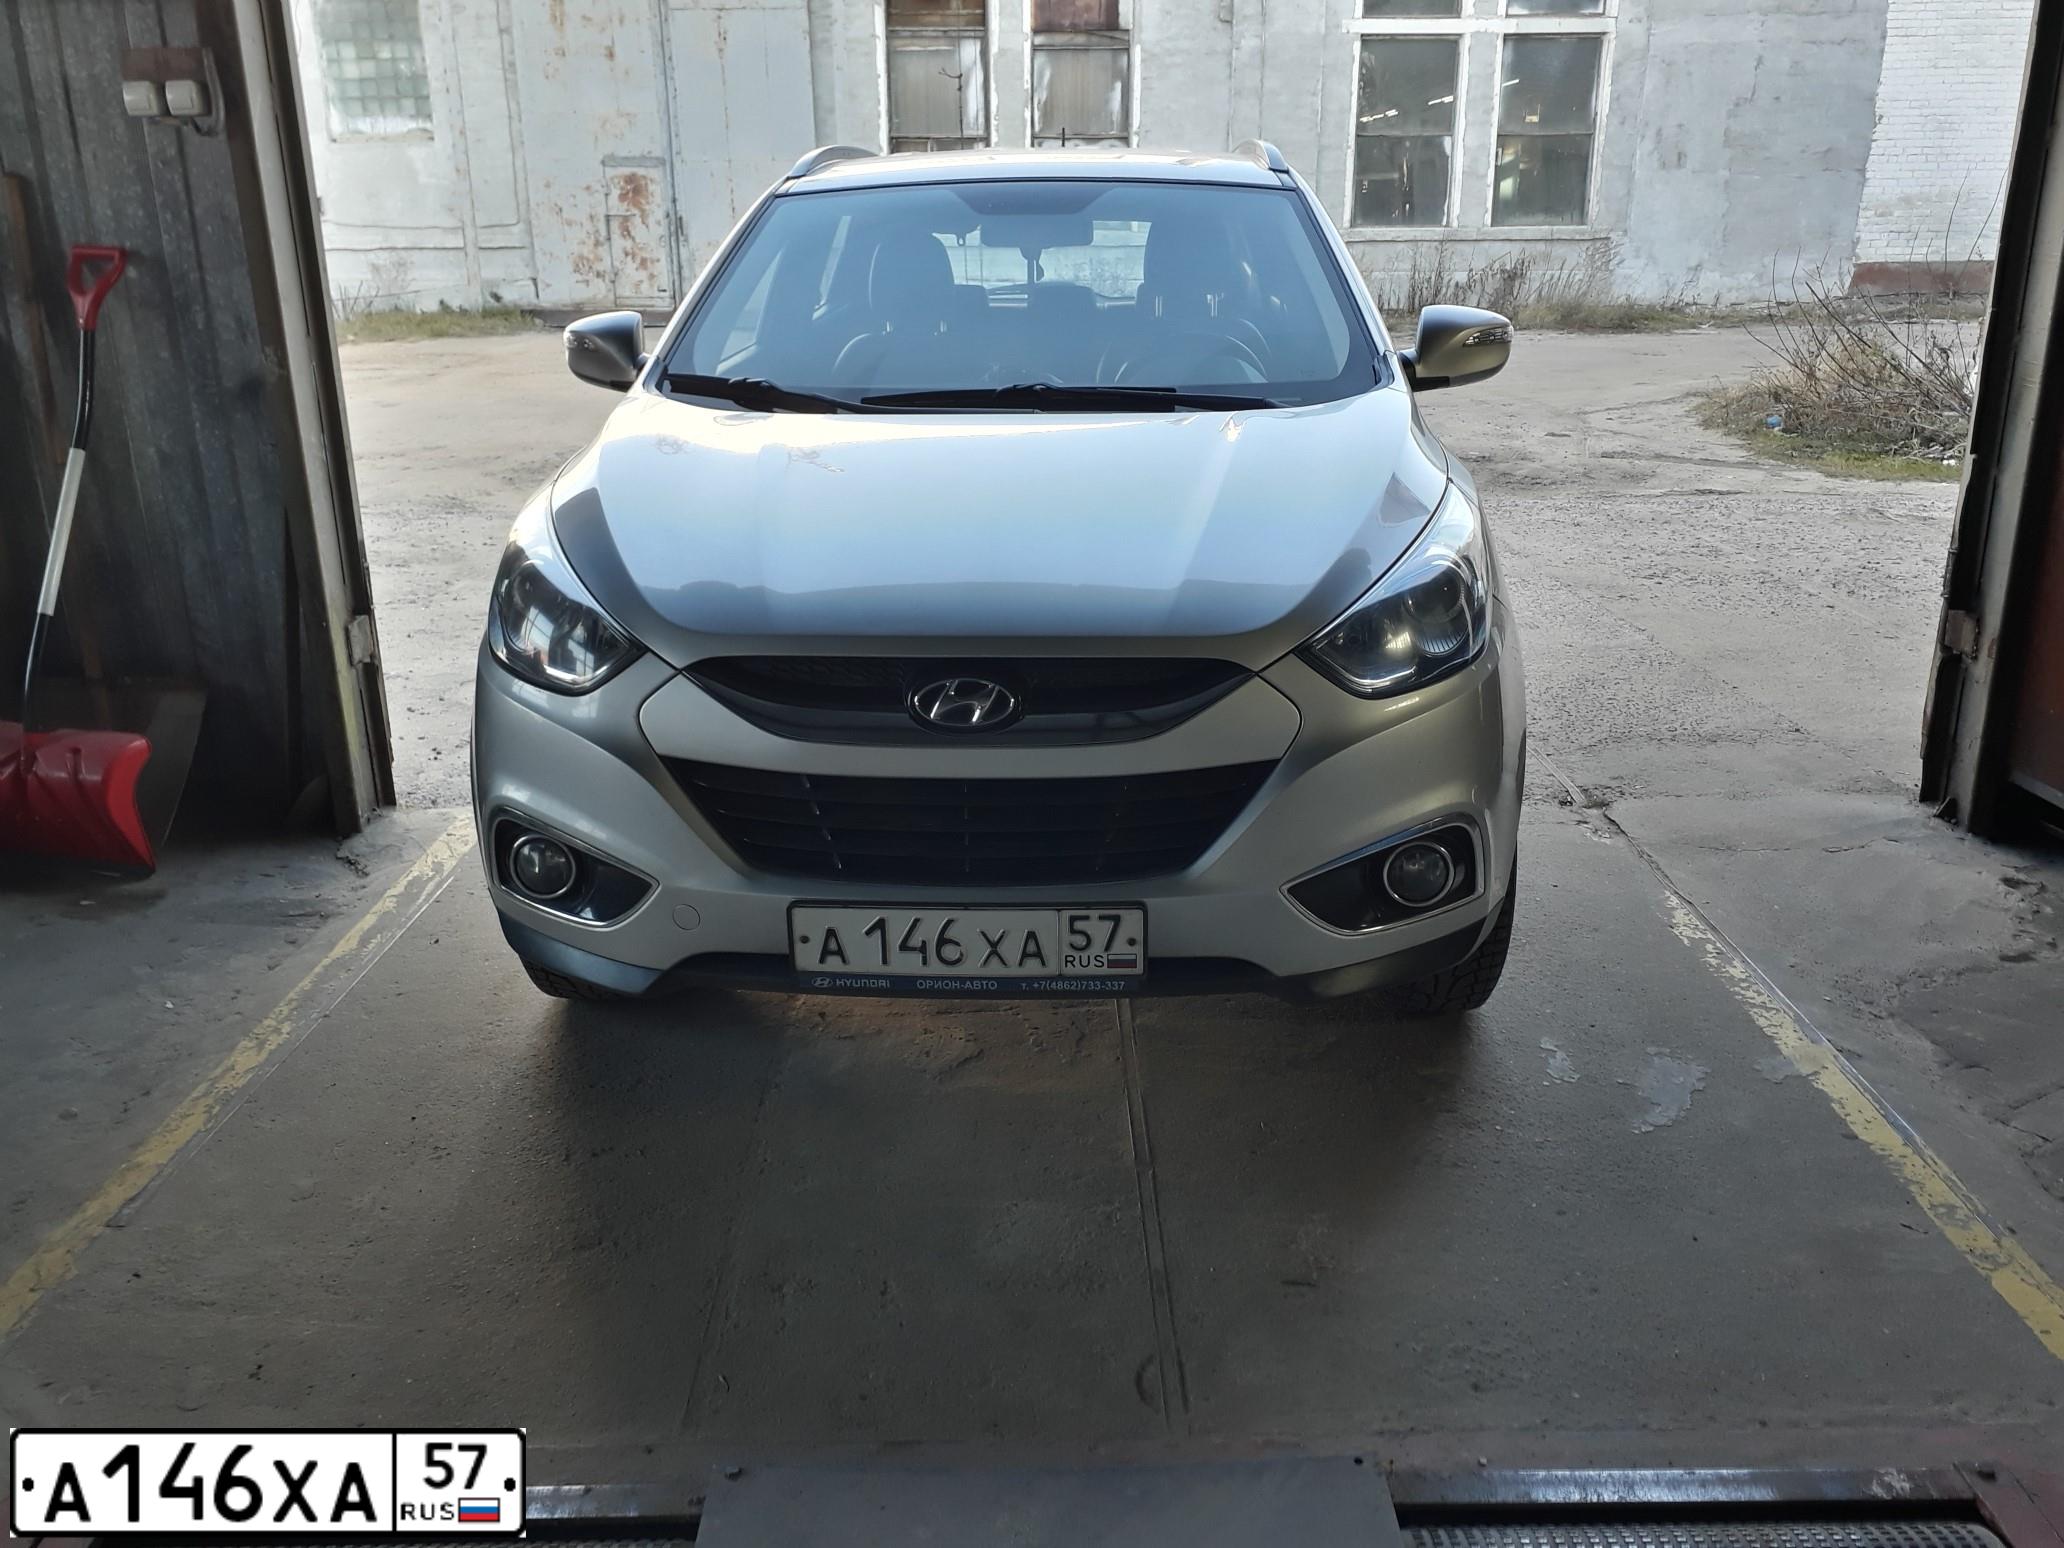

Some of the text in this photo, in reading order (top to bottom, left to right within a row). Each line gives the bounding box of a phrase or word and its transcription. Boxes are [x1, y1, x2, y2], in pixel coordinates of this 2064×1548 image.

[1067, 914, 1122, 951] 57
[1064, 954, 1105, 969] RUS
[836, 978, 890, 988] HYUNDAI
[916, 979, 998, 990] ОРИОН-АВТО
[1032, 980, 1126, 991] +7(4862)733-337
